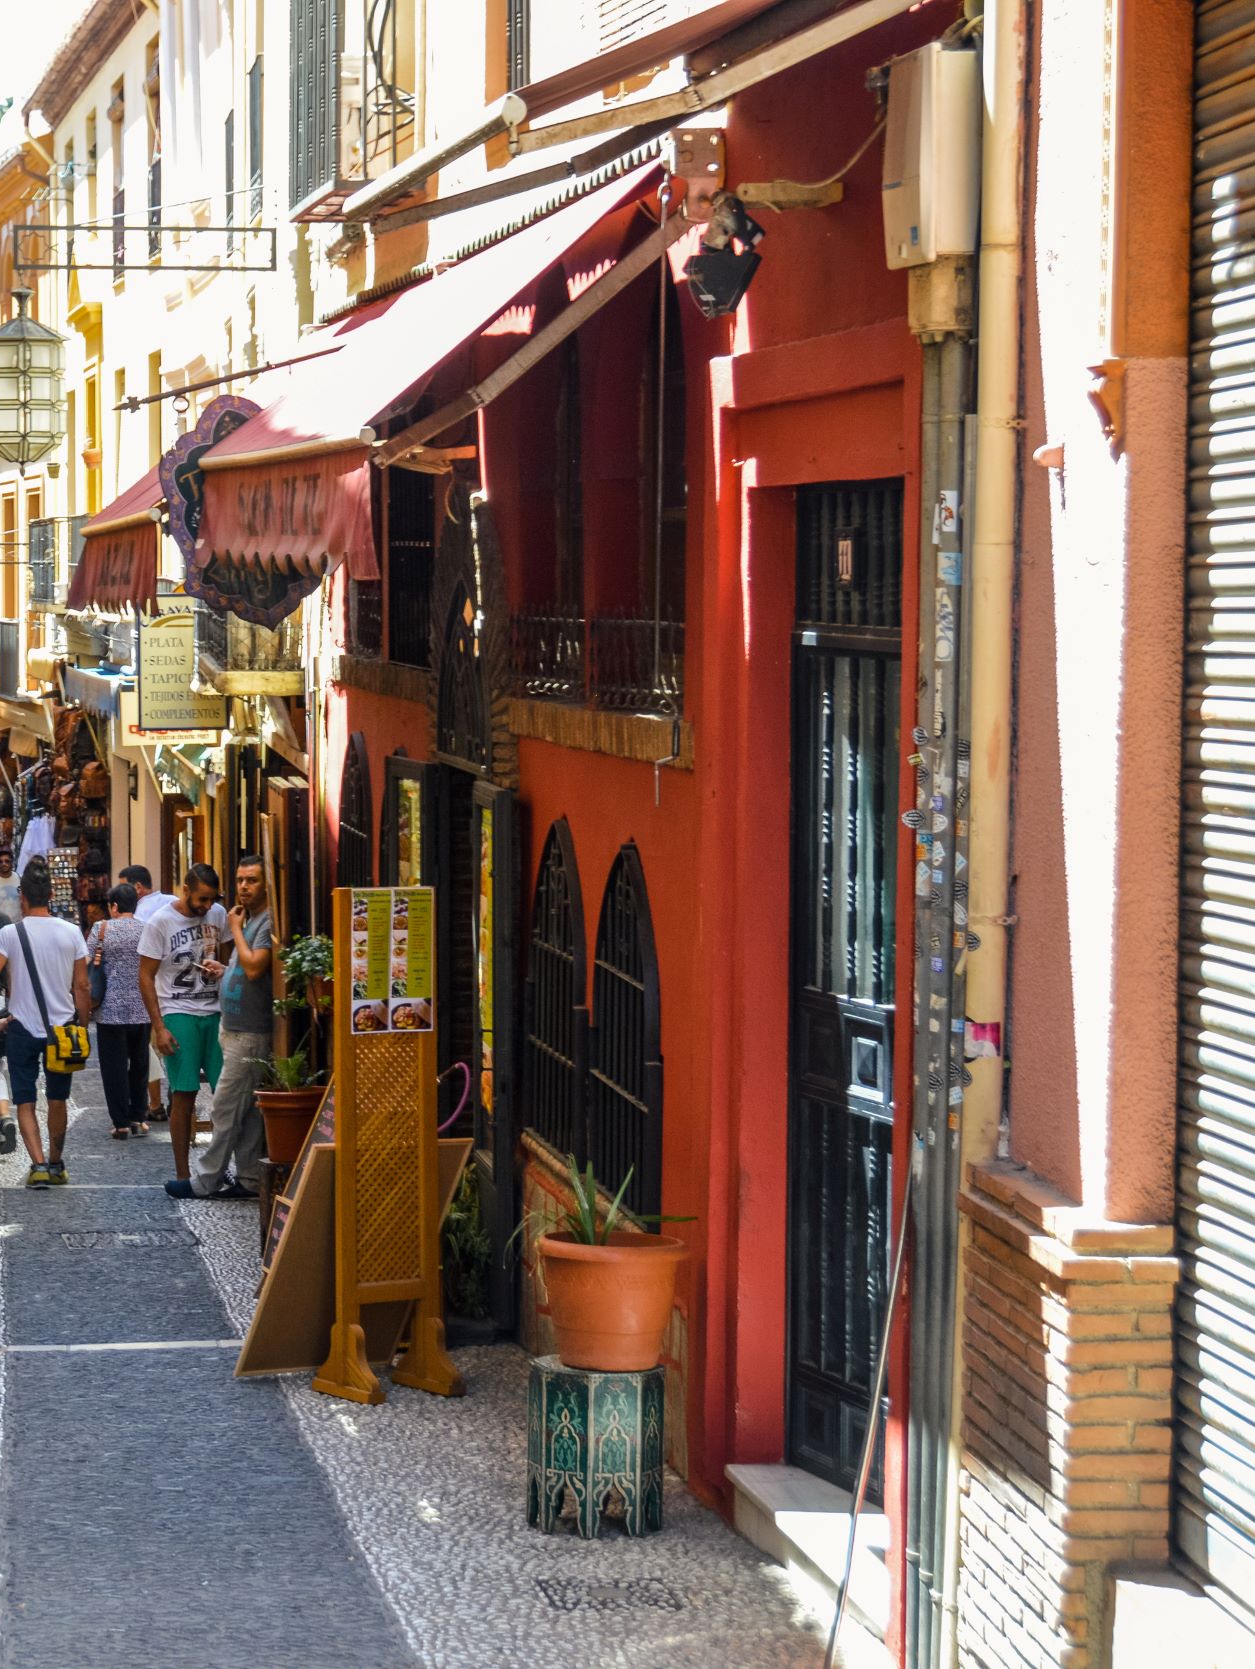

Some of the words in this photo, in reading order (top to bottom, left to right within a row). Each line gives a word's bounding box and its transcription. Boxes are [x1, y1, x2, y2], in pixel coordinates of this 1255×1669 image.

[149, 637, 185, 648] PLATA
[149, 655, 187, 666] SEDAS
[151, 673, 193, 684] TAPIC
[150, 690, 184, 703] TEJIDOS
[149, 708, 221, 720] COMPLEMENTOS
